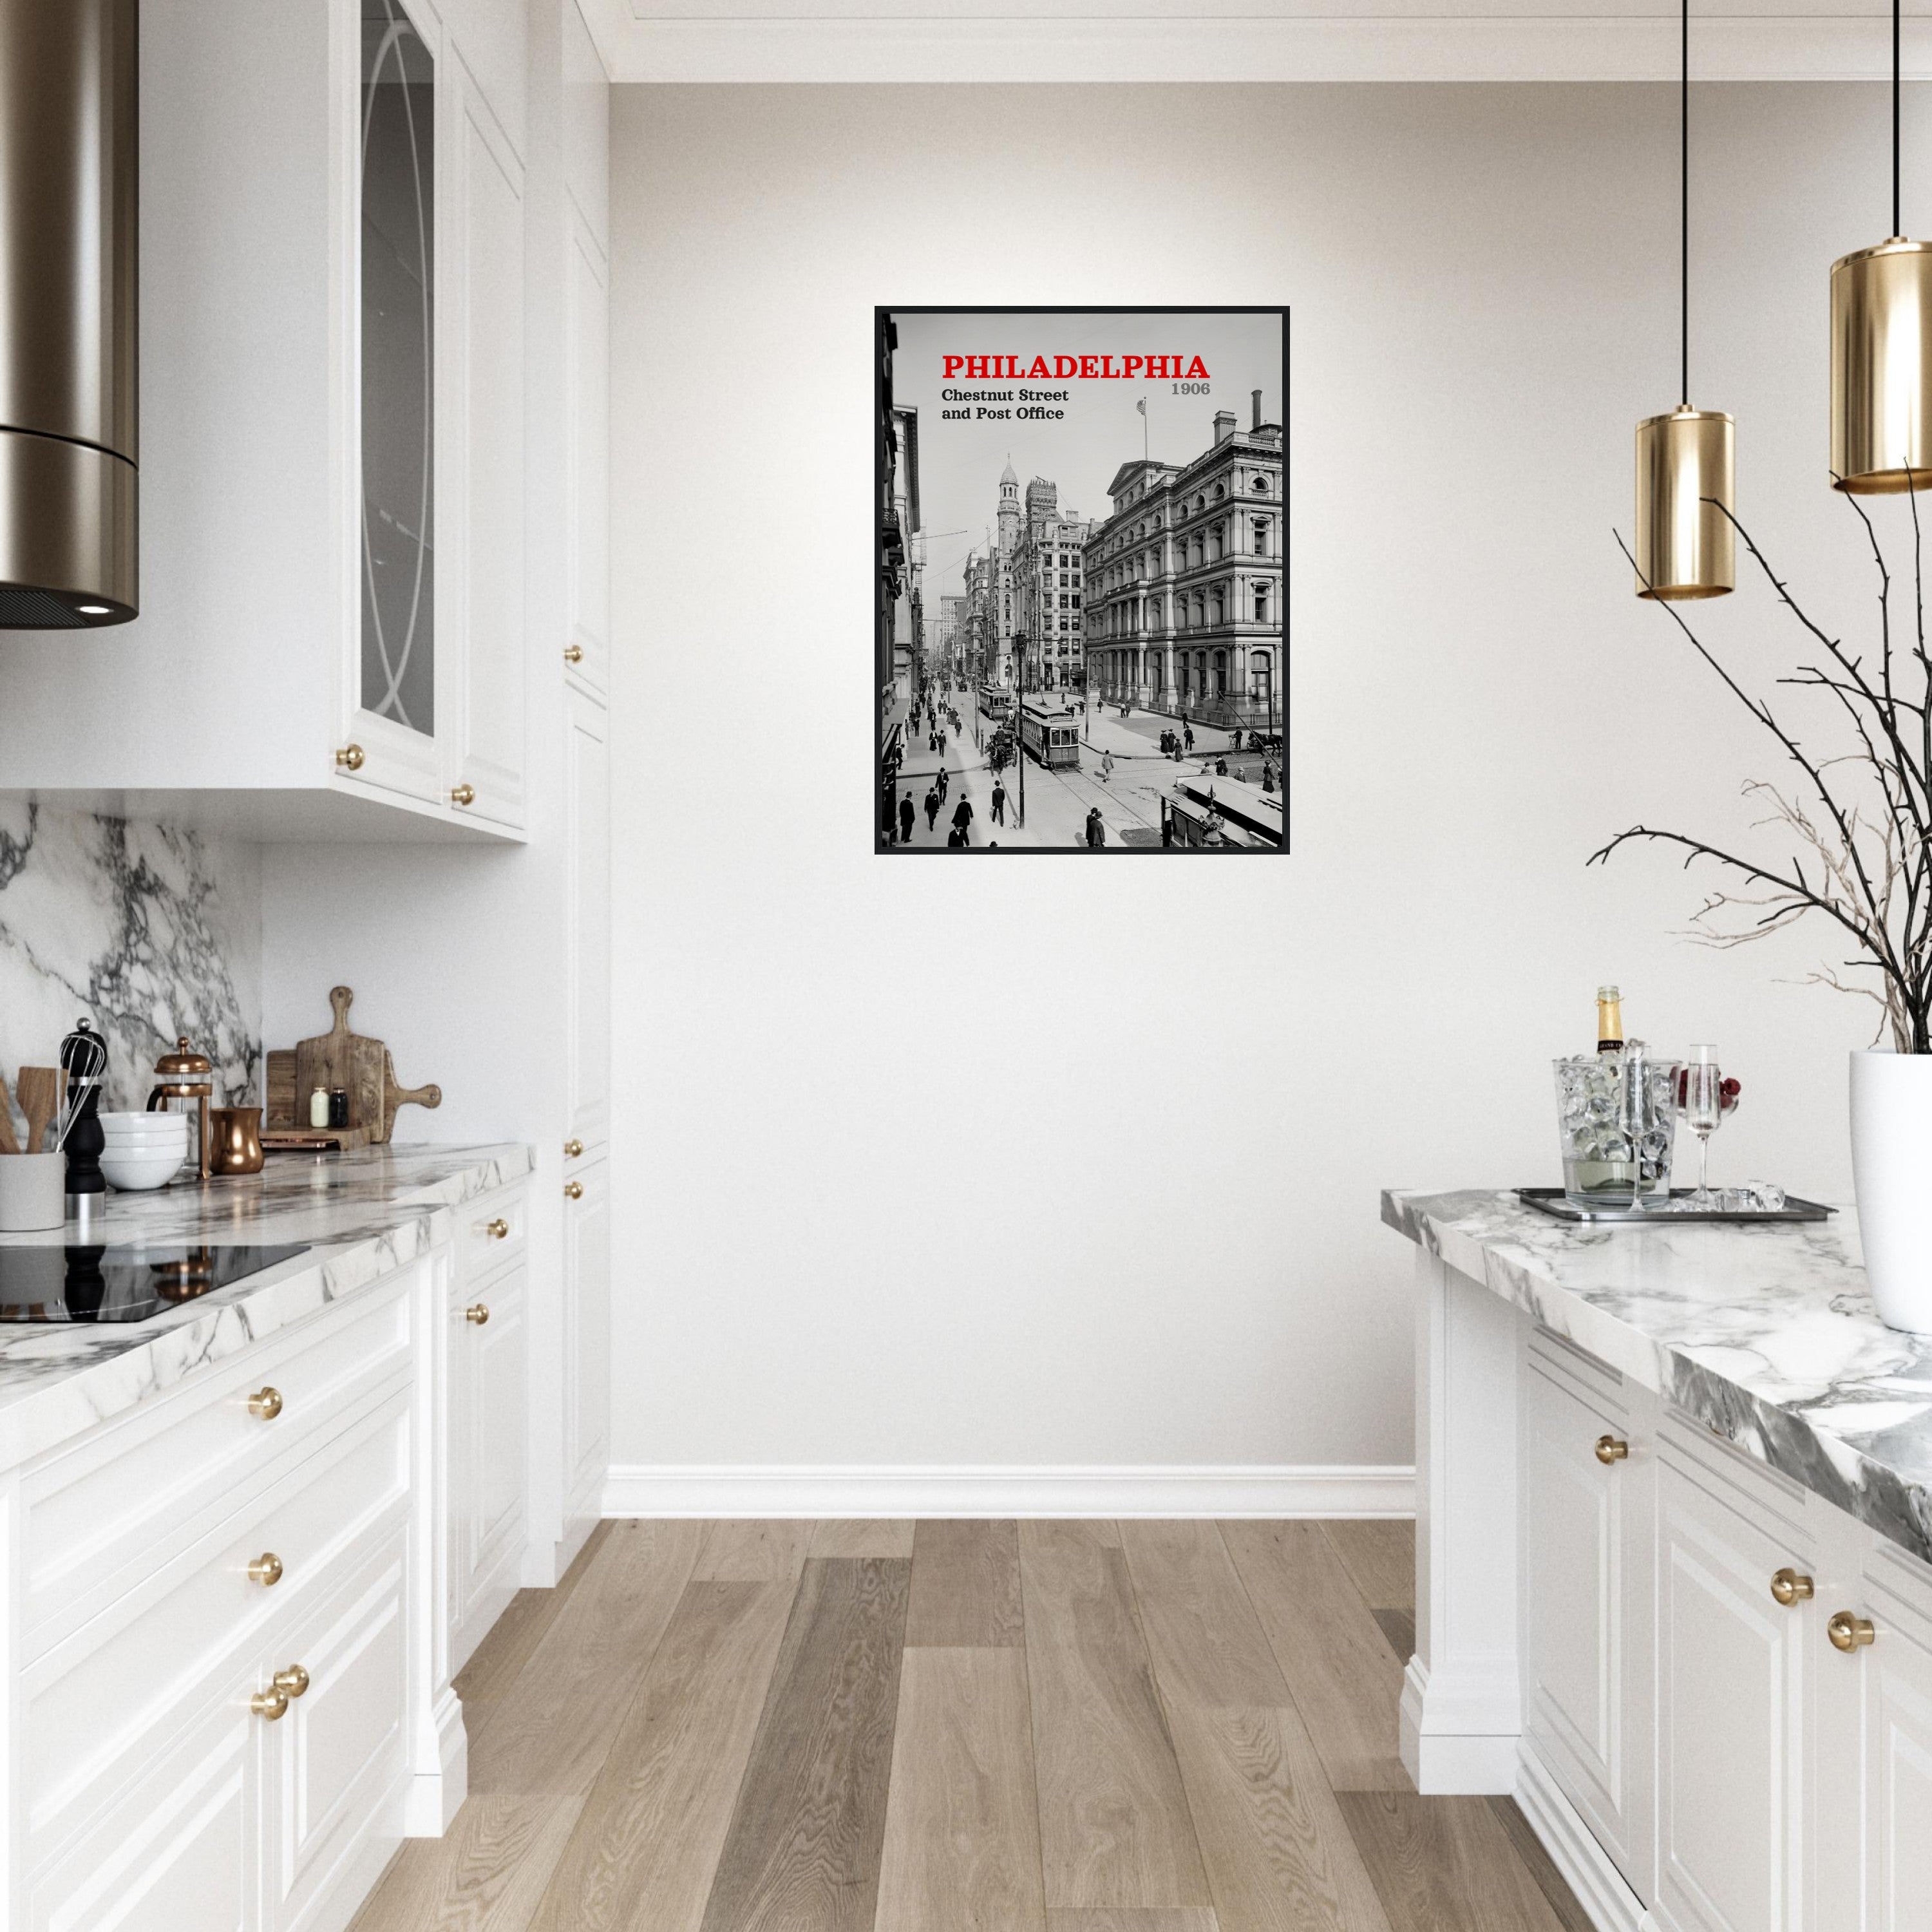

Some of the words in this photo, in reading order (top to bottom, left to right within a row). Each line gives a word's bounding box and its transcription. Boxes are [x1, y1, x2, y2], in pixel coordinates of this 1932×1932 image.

[942, 355, 1211, 379] PHILADELPHIA
[941, 388, 1014, 401] Chestnut
[1018, 388, 1070, 401] Street
[1171, 383, 1211, 395] 1906
[942, 407, 972, 420] and
[976, 407, 1012, 420] Post
[1016, 406, 1065, 420] Office
